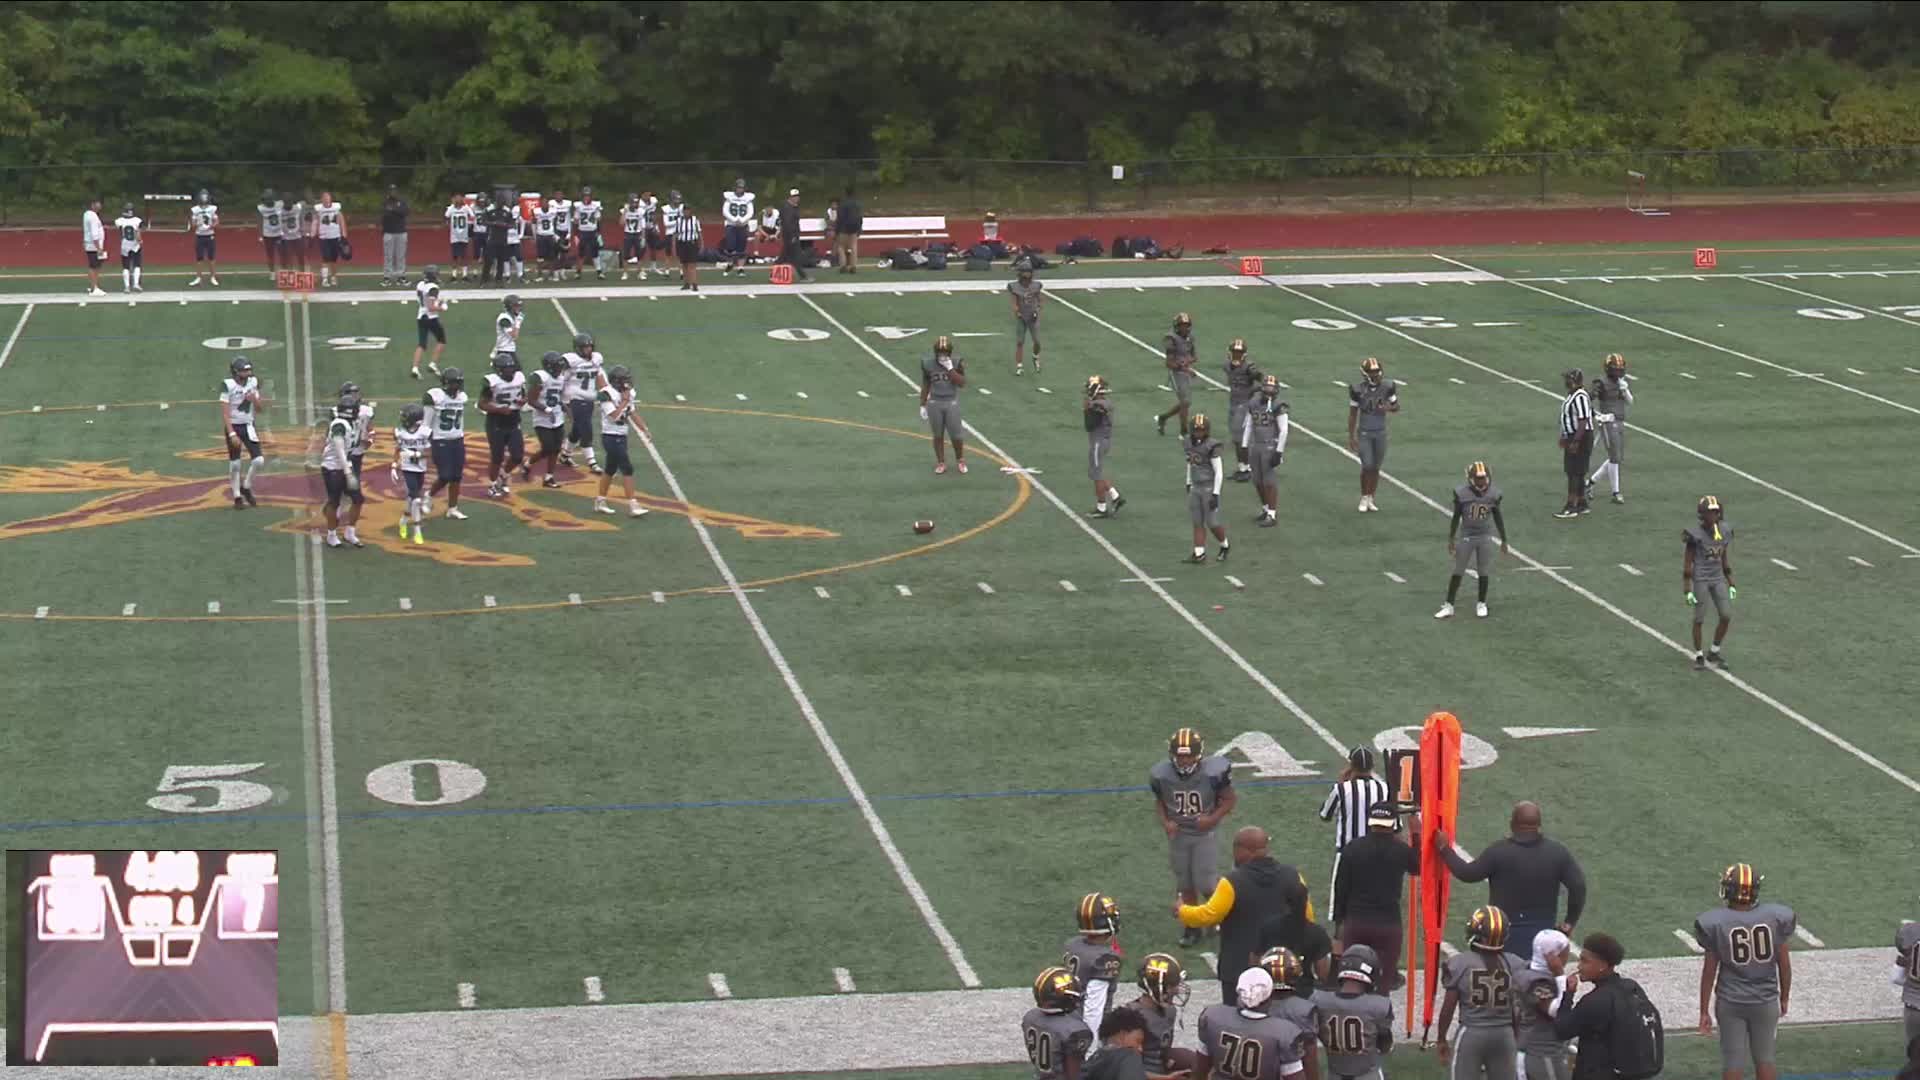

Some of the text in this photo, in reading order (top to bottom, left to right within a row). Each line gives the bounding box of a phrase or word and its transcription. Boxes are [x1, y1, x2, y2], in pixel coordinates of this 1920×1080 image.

[453, 215, 466, 229] 10
[729, 203, 747, 217] 66
[775, 267, 789, 281] 40
[1245, 259, 1261, 273] 30
[1699, 250, 1713, 265] 20
[1398, 755, 1413, 801] 1
[1174, 790, 1203, 817] 79
[1729, 923, 1774, 966] 60
[1470, 968, 1513, 1009] 52
[1027, 1027, 1052, 1076] 20
[1327, 1014, 1365, 1055] 10
[1220, 1031, 1262, 1080] 70
